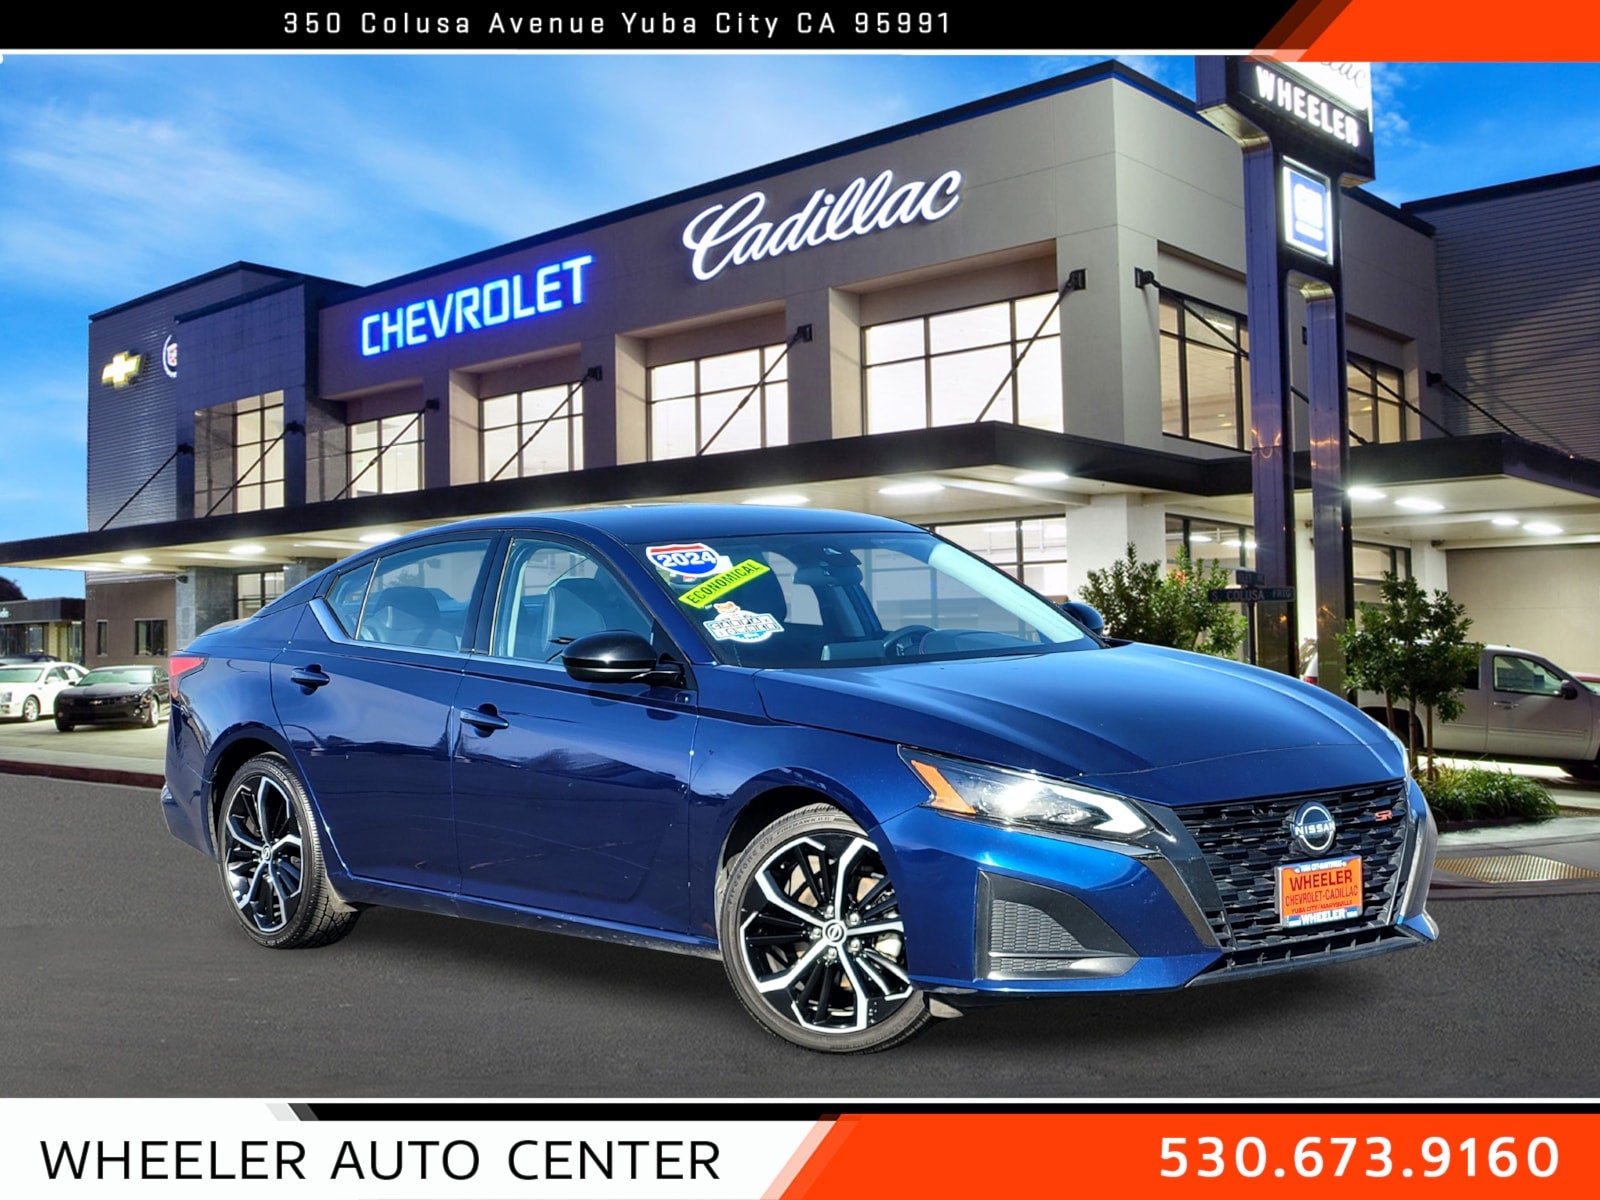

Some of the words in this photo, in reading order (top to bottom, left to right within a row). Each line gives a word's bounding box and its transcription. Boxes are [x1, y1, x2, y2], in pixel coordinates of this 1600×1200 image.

[1255, 65, 1360, 148] WHEELER
[682, 168, 962, 281] Cadillac
[361, 254, 594, 357] CHEVROLET
[657, 550, 717, 567] 2024
[686, 562, 761, 604] ECONOMICAL
[1226, 589, 1266, 601] COLUSA
[1374, 809, 1393, 822] SR
[1294, 821, 1336, 836] NISSAN
[1289, 869, 1353, 892] WHEELER
[1285, 884, 1359, 907] CHEVROLET-CADILLAC
[1300, 908, 1346, 925] WHEELER
